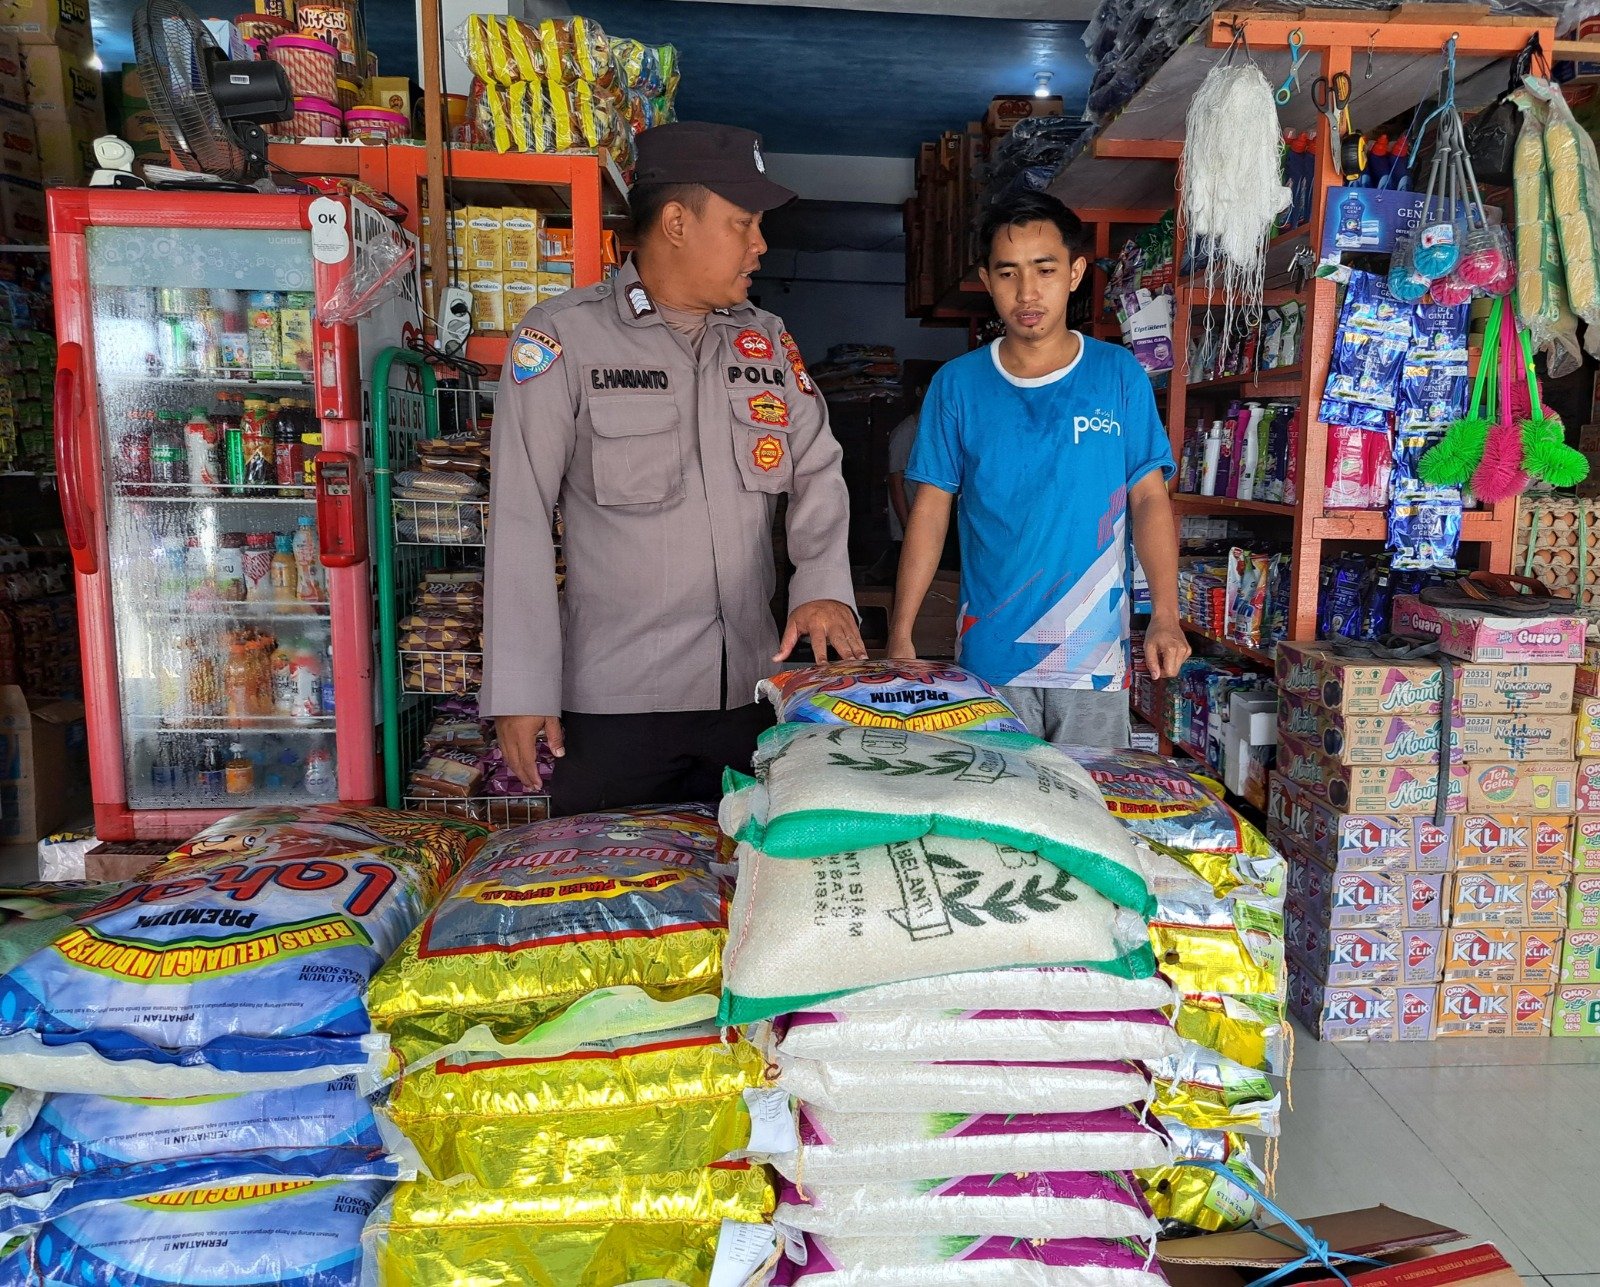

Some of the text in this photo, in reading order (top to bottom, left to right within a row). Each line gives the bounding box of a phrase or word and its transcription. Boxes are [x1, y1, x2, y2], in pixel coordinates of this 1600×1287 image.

[299, 8, 346, 29] Nitchi
[318, 213, 338, 225] OK
[268, 236, 303, 245] UCHIDA
[1134, 323, 1167, 333] Ciptadent
[591, 368, 669, 390] E.HARIANTO
[728, 366, 785, 387] POLR
[1073, 409, 1121, 444] posh
[1411, 614, 1442, 635] Guava
[1516, 630, 1562, 645] Guava
[1465, 670, 1490, 678] 20324
[870, 690, 949, 704] PREMIUM
[1382, 680, 1446, 711] Mounte
[905, 706, 975, 731] KELUARGA
[1465, 718, 1490, 726] 20324
[1489, 768, 1509, 780] Teh
[1482, 778, 1514, 792] Gelas
[1345, 819, 1368, 829] OKKY
[1465, 818, 1486, 828] OKKY
[1342, 828, 1411, 850] KLIK
[1460, 827, 1529, 849] KLIK
[474, 847, 695, 875] Ubur-Ubur
[1340, 876, 1362, 886] OKKY
[1461, 877, 1482, 886] OKKY
[1334, 886, 1403, 907] KLIK
[1457, 883, 1525, 906] KLIK
[135, 909, 259, 929] PREMIUM
[280, 919, 355, 951] BERAS
[1336, 933, 1358, 944] OKKY
[1455, 933, 1477, 942] OKKY
[160, 933, 278, 977] KELUARGA
[1332, 943, 1400, 964] KLIK
[1447, 942, 1518, 963] KLIK
[301, 965, 340, 975] SOSOH
[298, 972, 336, 983] UMUM
[1331, 991, 1354, 1001] OKKY
[1446, 987, 1467, 996] OKKY
[1327, 1000, 1395, 1021] KLIK
[1441, 995, 1509, 1016] KLIK
[333, 1203, 368, 1216] UMUM
[336, 1196, 371, 1209] SOSOH
[172, 1238, 229, 1251] PERHATIAN
